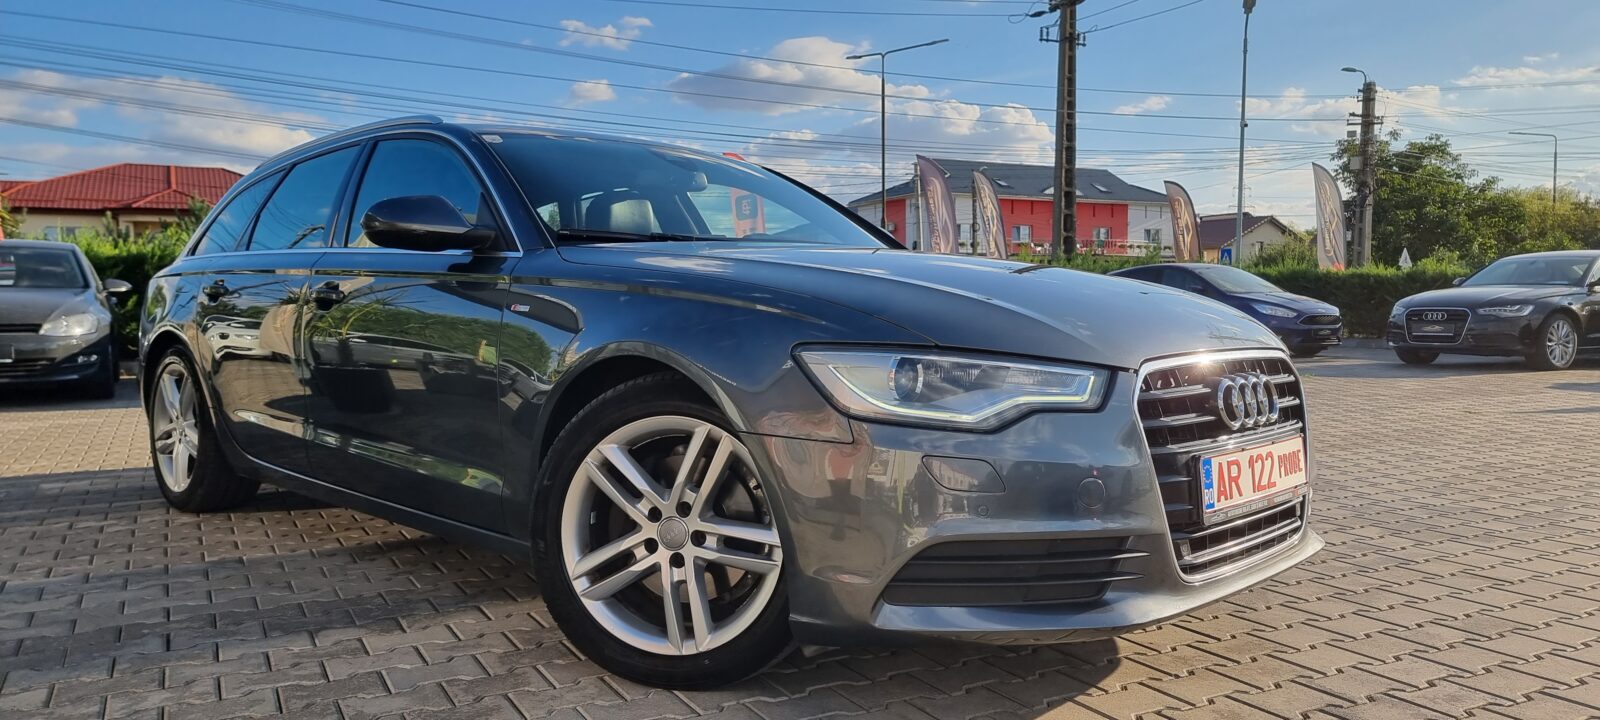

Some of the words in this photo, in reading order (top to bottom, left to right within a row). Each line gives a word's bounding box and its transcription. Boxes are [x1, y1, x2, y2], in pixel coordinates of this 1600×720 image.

[1216, 459, 1243, 503] AR
[1248, 451, 1276, 493] 122
[1277, 450, 1303, 478] PROBE
